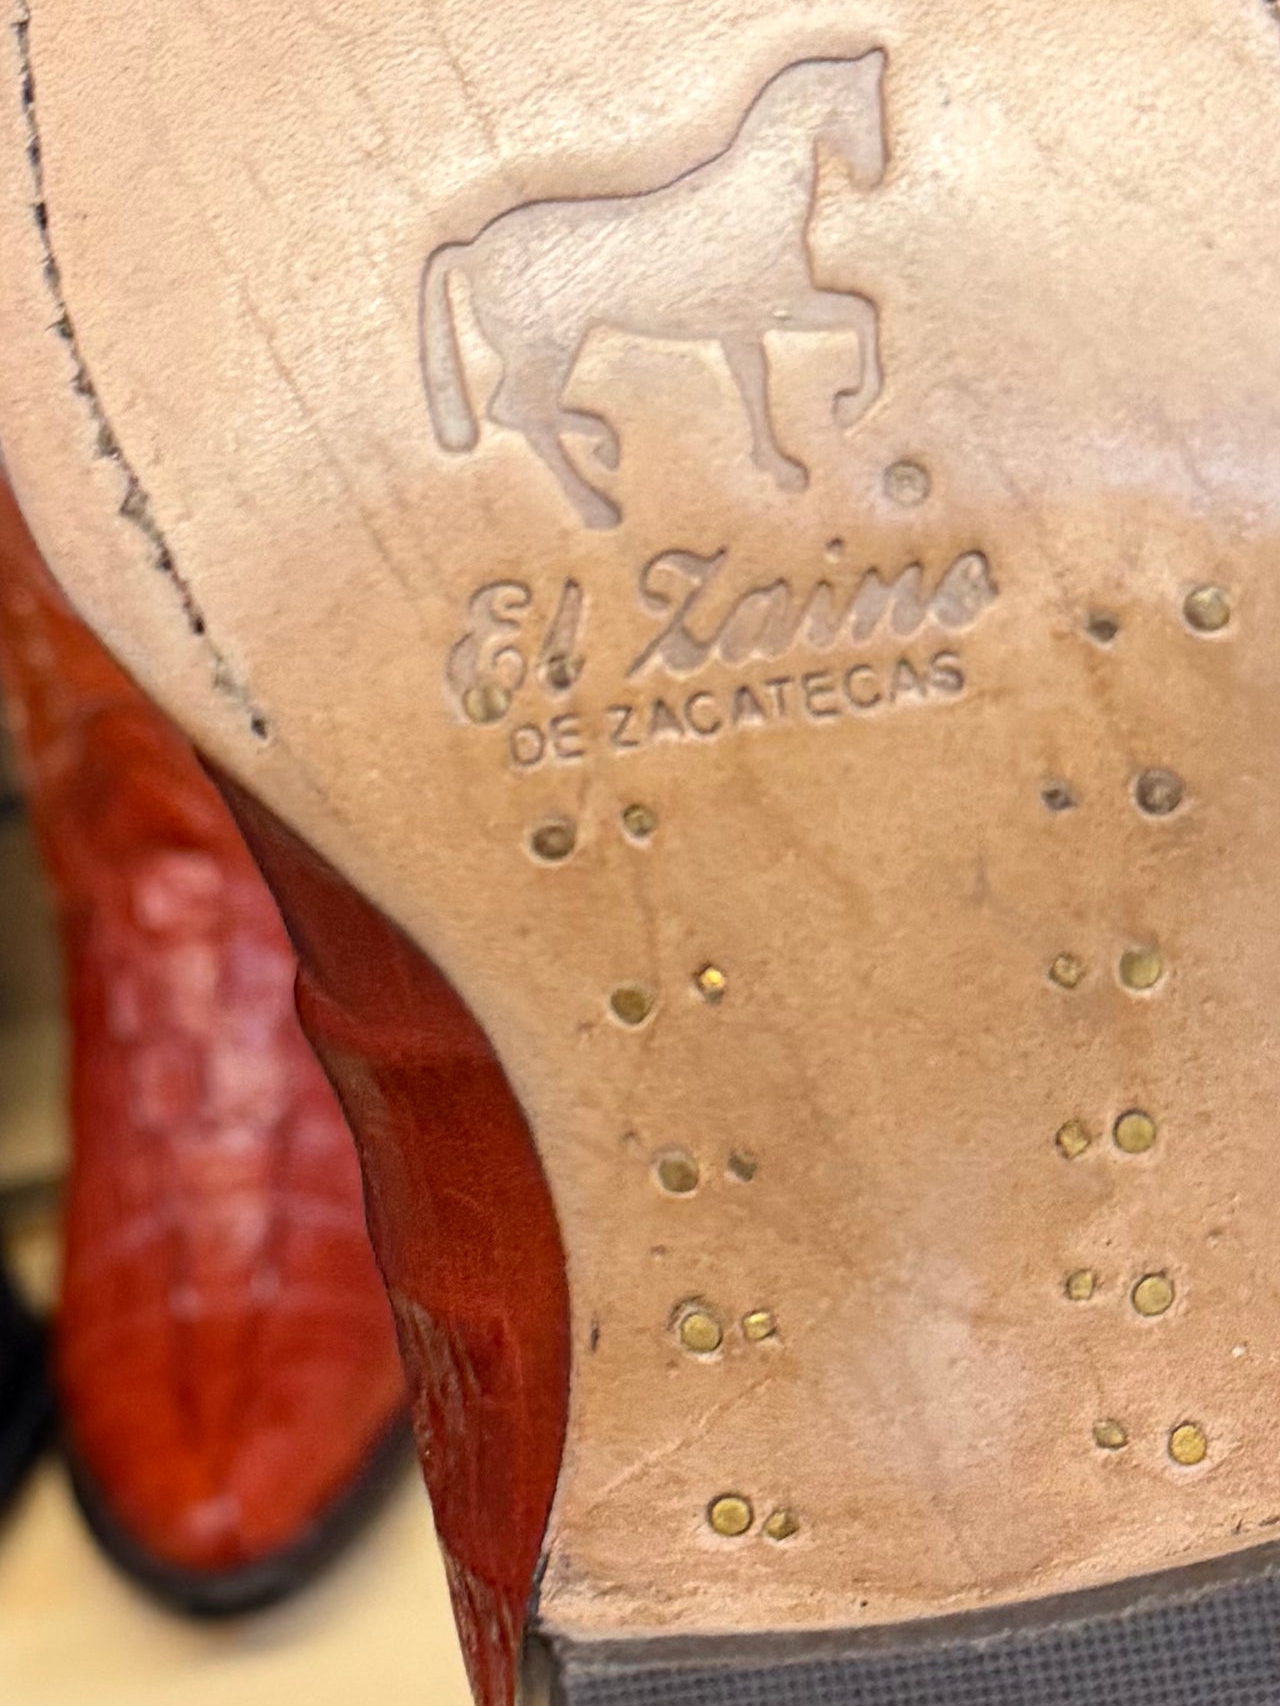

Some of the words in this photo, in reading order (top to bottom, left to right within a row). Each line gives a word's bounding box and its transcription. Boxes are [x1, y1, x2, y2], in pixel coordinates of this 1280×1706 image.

[447, 578, 586, 723] El
[509, 714, 586, 768] DE
[607, 650, 968, 748] ZACATECAS
